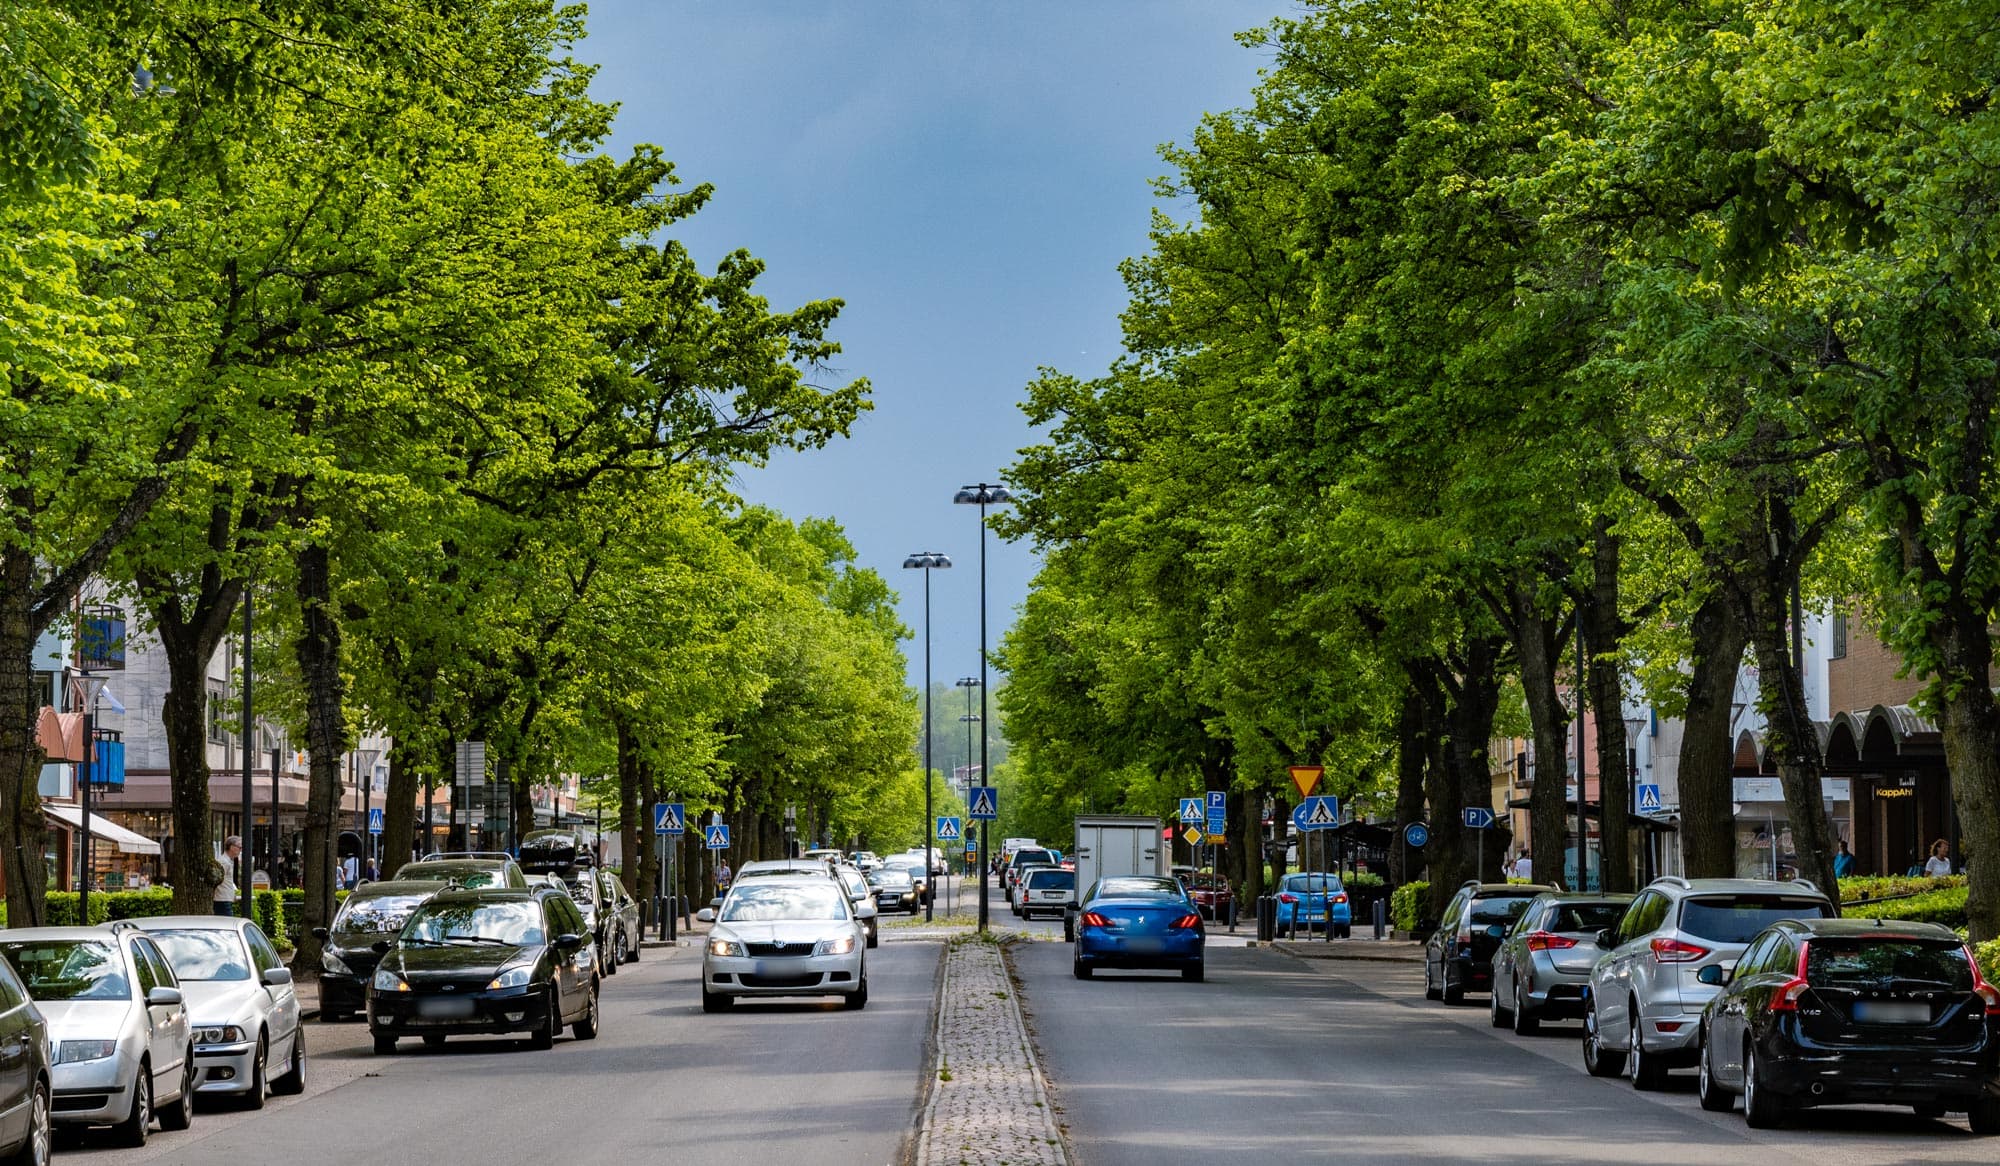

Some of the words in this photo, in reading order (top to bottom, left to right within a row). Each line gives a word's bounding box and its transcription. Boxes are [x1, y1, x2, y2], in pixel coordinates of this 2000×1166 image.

[1876, 788, 1912, 798] KappAhl
[1212, 794, 1221, 806] P
[1470, 811, 1476, 823] P
[1852, 991, 1934, 999] VOLVO
